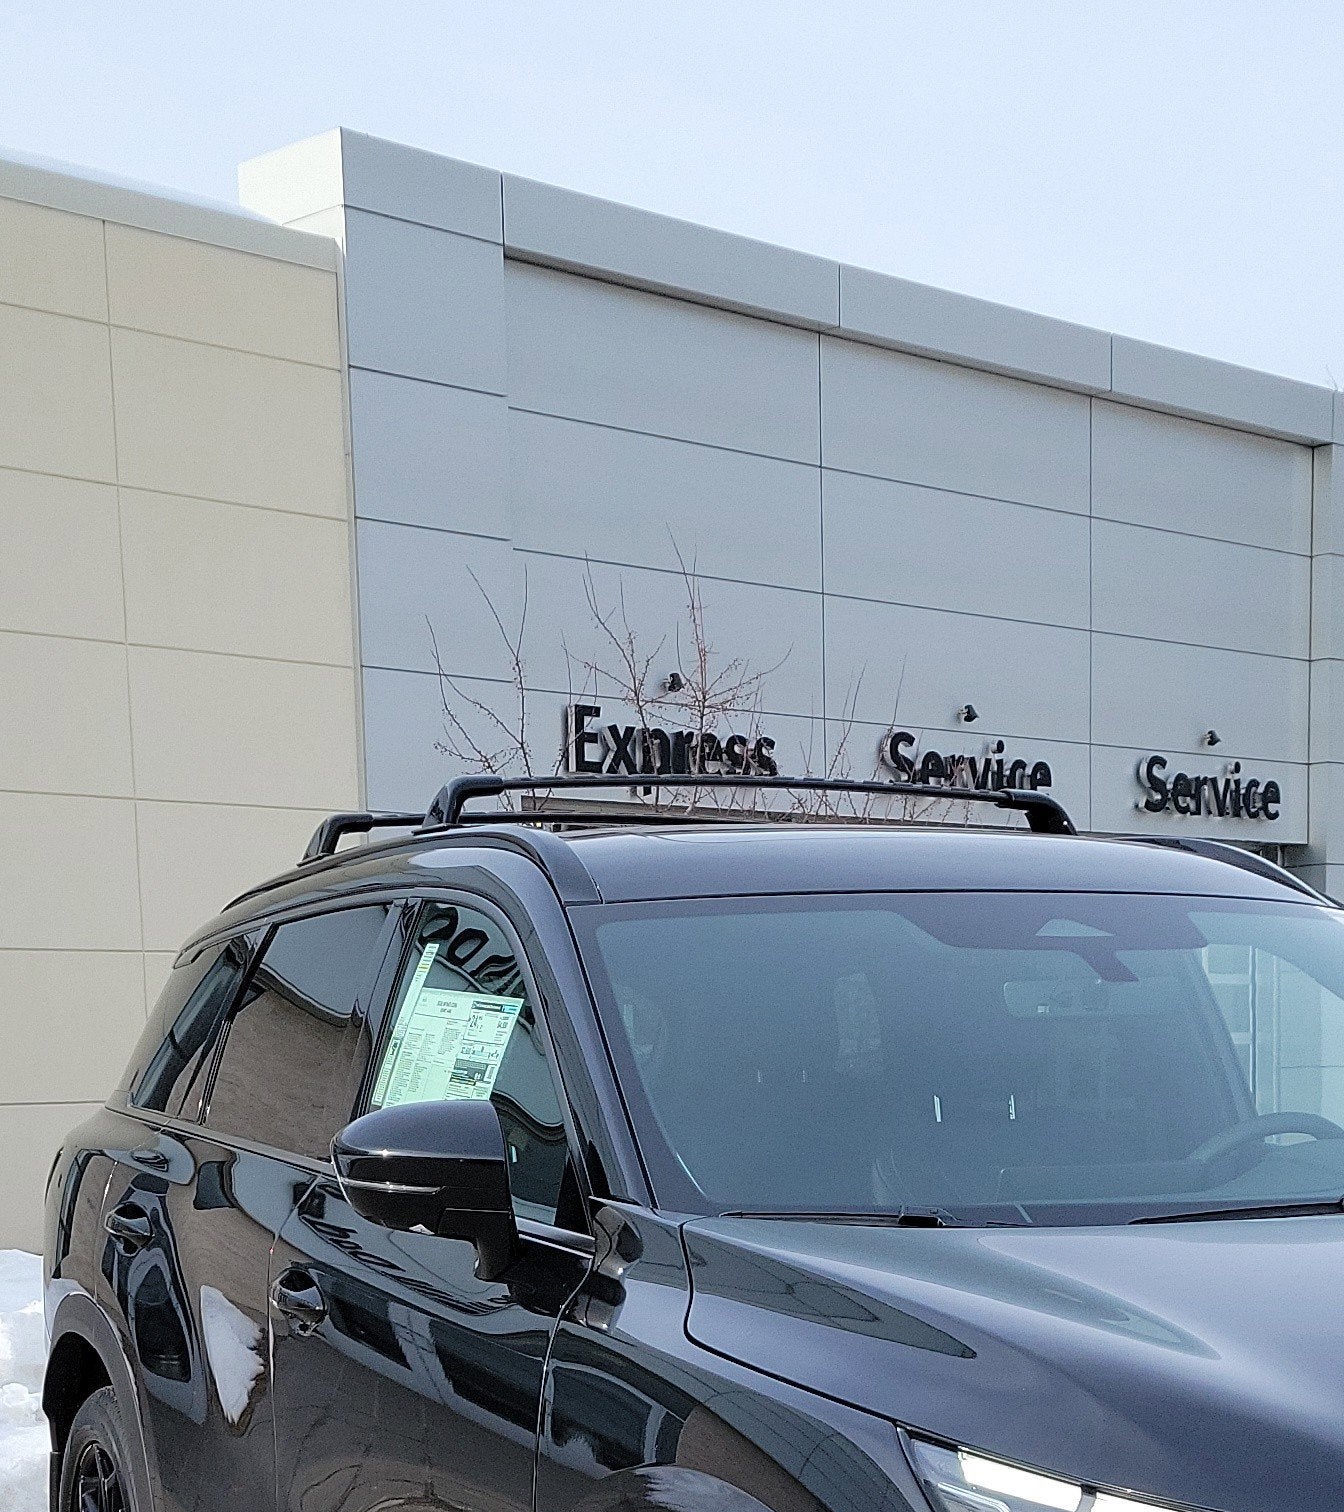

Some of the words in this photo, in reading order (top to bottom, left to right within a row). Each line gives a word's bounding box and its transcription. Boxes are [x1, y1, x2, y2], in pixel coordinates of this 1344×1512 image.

[567, 703, 779, 796] Express
[884, 730, 1053, 791] Service
[1139, 754, 1282, 821] Service
